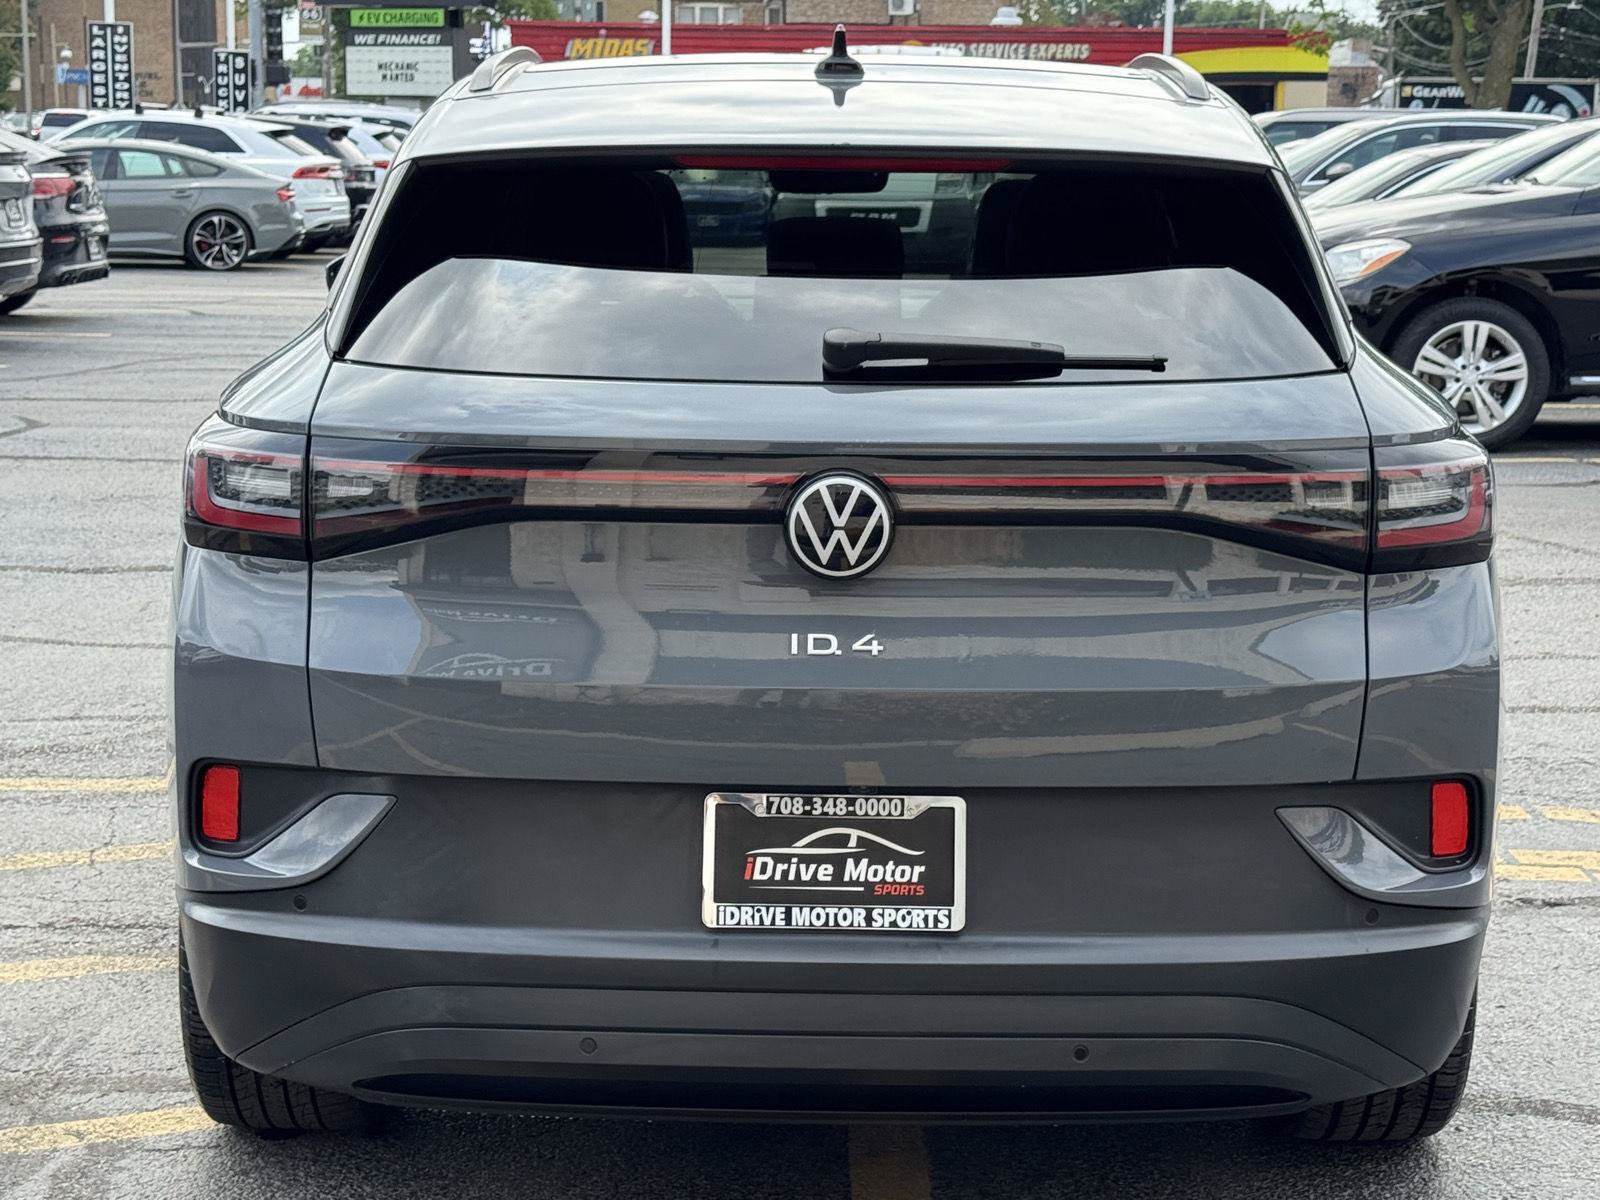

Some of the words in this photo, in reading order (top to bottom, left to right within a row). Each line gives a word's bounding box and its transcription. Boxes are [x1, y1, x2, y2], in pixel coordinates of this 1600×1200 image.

[367, 13, 380, 23] EV
[383, 12, 439, 23] CHARGING
[354, 34, 375, 45] WE
[377, 34, 442, 45] FINANCE!
[570, 37, 650, 59] MIDAS
[969, 43, 1027, 59] SERVICE
[1029, 43, 1090, 60] EXPERTS
[91, 25, 107, 107] LARGEST
[113, 26, 130, 108] INVENTORY
[217, 52, 229, 110] TRUCK
[768, 796, 902, 816] 708-348-0000
[744, 856, 834, 881] iDrive
[844, 858, 926, 883] Motor
[874, 884, 925, 896] SPORTS
[791, 907, 866, 927] MOTOR
[872, 907, 950, 929] SPORTS
